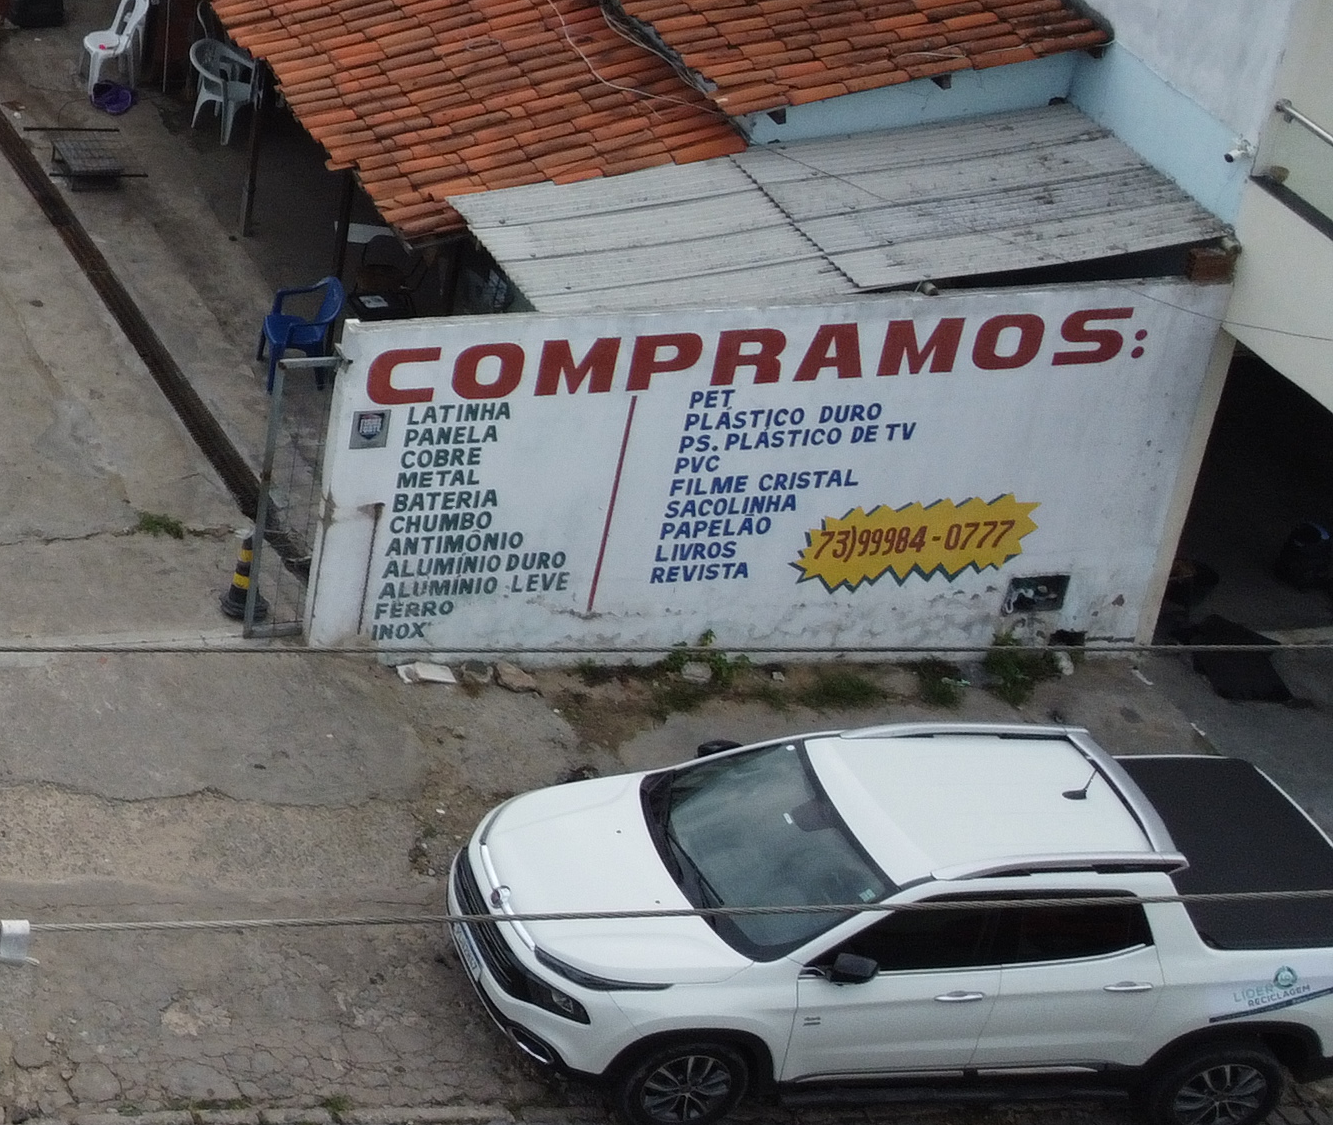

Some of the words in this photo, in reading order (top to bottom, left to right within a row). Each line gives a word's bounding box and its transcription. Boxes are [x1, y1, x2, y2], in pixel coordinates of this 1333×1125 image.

[366, 306, 1149, 405] COMPRAMOS:
[688, 388, 736, 410] PET
[407, 402, 511, 426] LATINHA
[684, 406, 805, 432] PLÁSTICO
[819, 402, 883, 425] DURO
[403, 425, 498, 448] PANELA
[678, 434, 720, 454] PS.
[724, 426, 843, 452] PLÁSTICO
[850, 425, 879, 445] DE
[885, 421, 917, 443] TV
[400, 447, 482, 470] COBRE
[674, 455, 721, 475] PVC
[396, 469, 480, 489] METAL
[669, 474, 749, 497] FILME
[758, 469, 860, 493] CRISTAL
[392, 489, 498, 513] BATERIA
[664, 494, 797, 519] SACOLINHA
[389, 511, 493, 535] CHUMBO
[659, 513, 772, 541] PAPELÃO
[385, 529, 524, 557] ANTIMÔNIO
[654, 541, 737, 563] LIVROS
[381, 552, 501, 580] ALUMÍNIO
[505, 551, 566, 573] DURO
[649, 561, 750, 585] REVISTA
[377, 574, 498, 600] ALUMÍNIO
[511, 571, 570, 593] LEVE
[374, 599, 454, 621] FERRO
[370, 621, 426, 642] INOX
[1247, 984, 1311, 1007] RECICLAGEM
